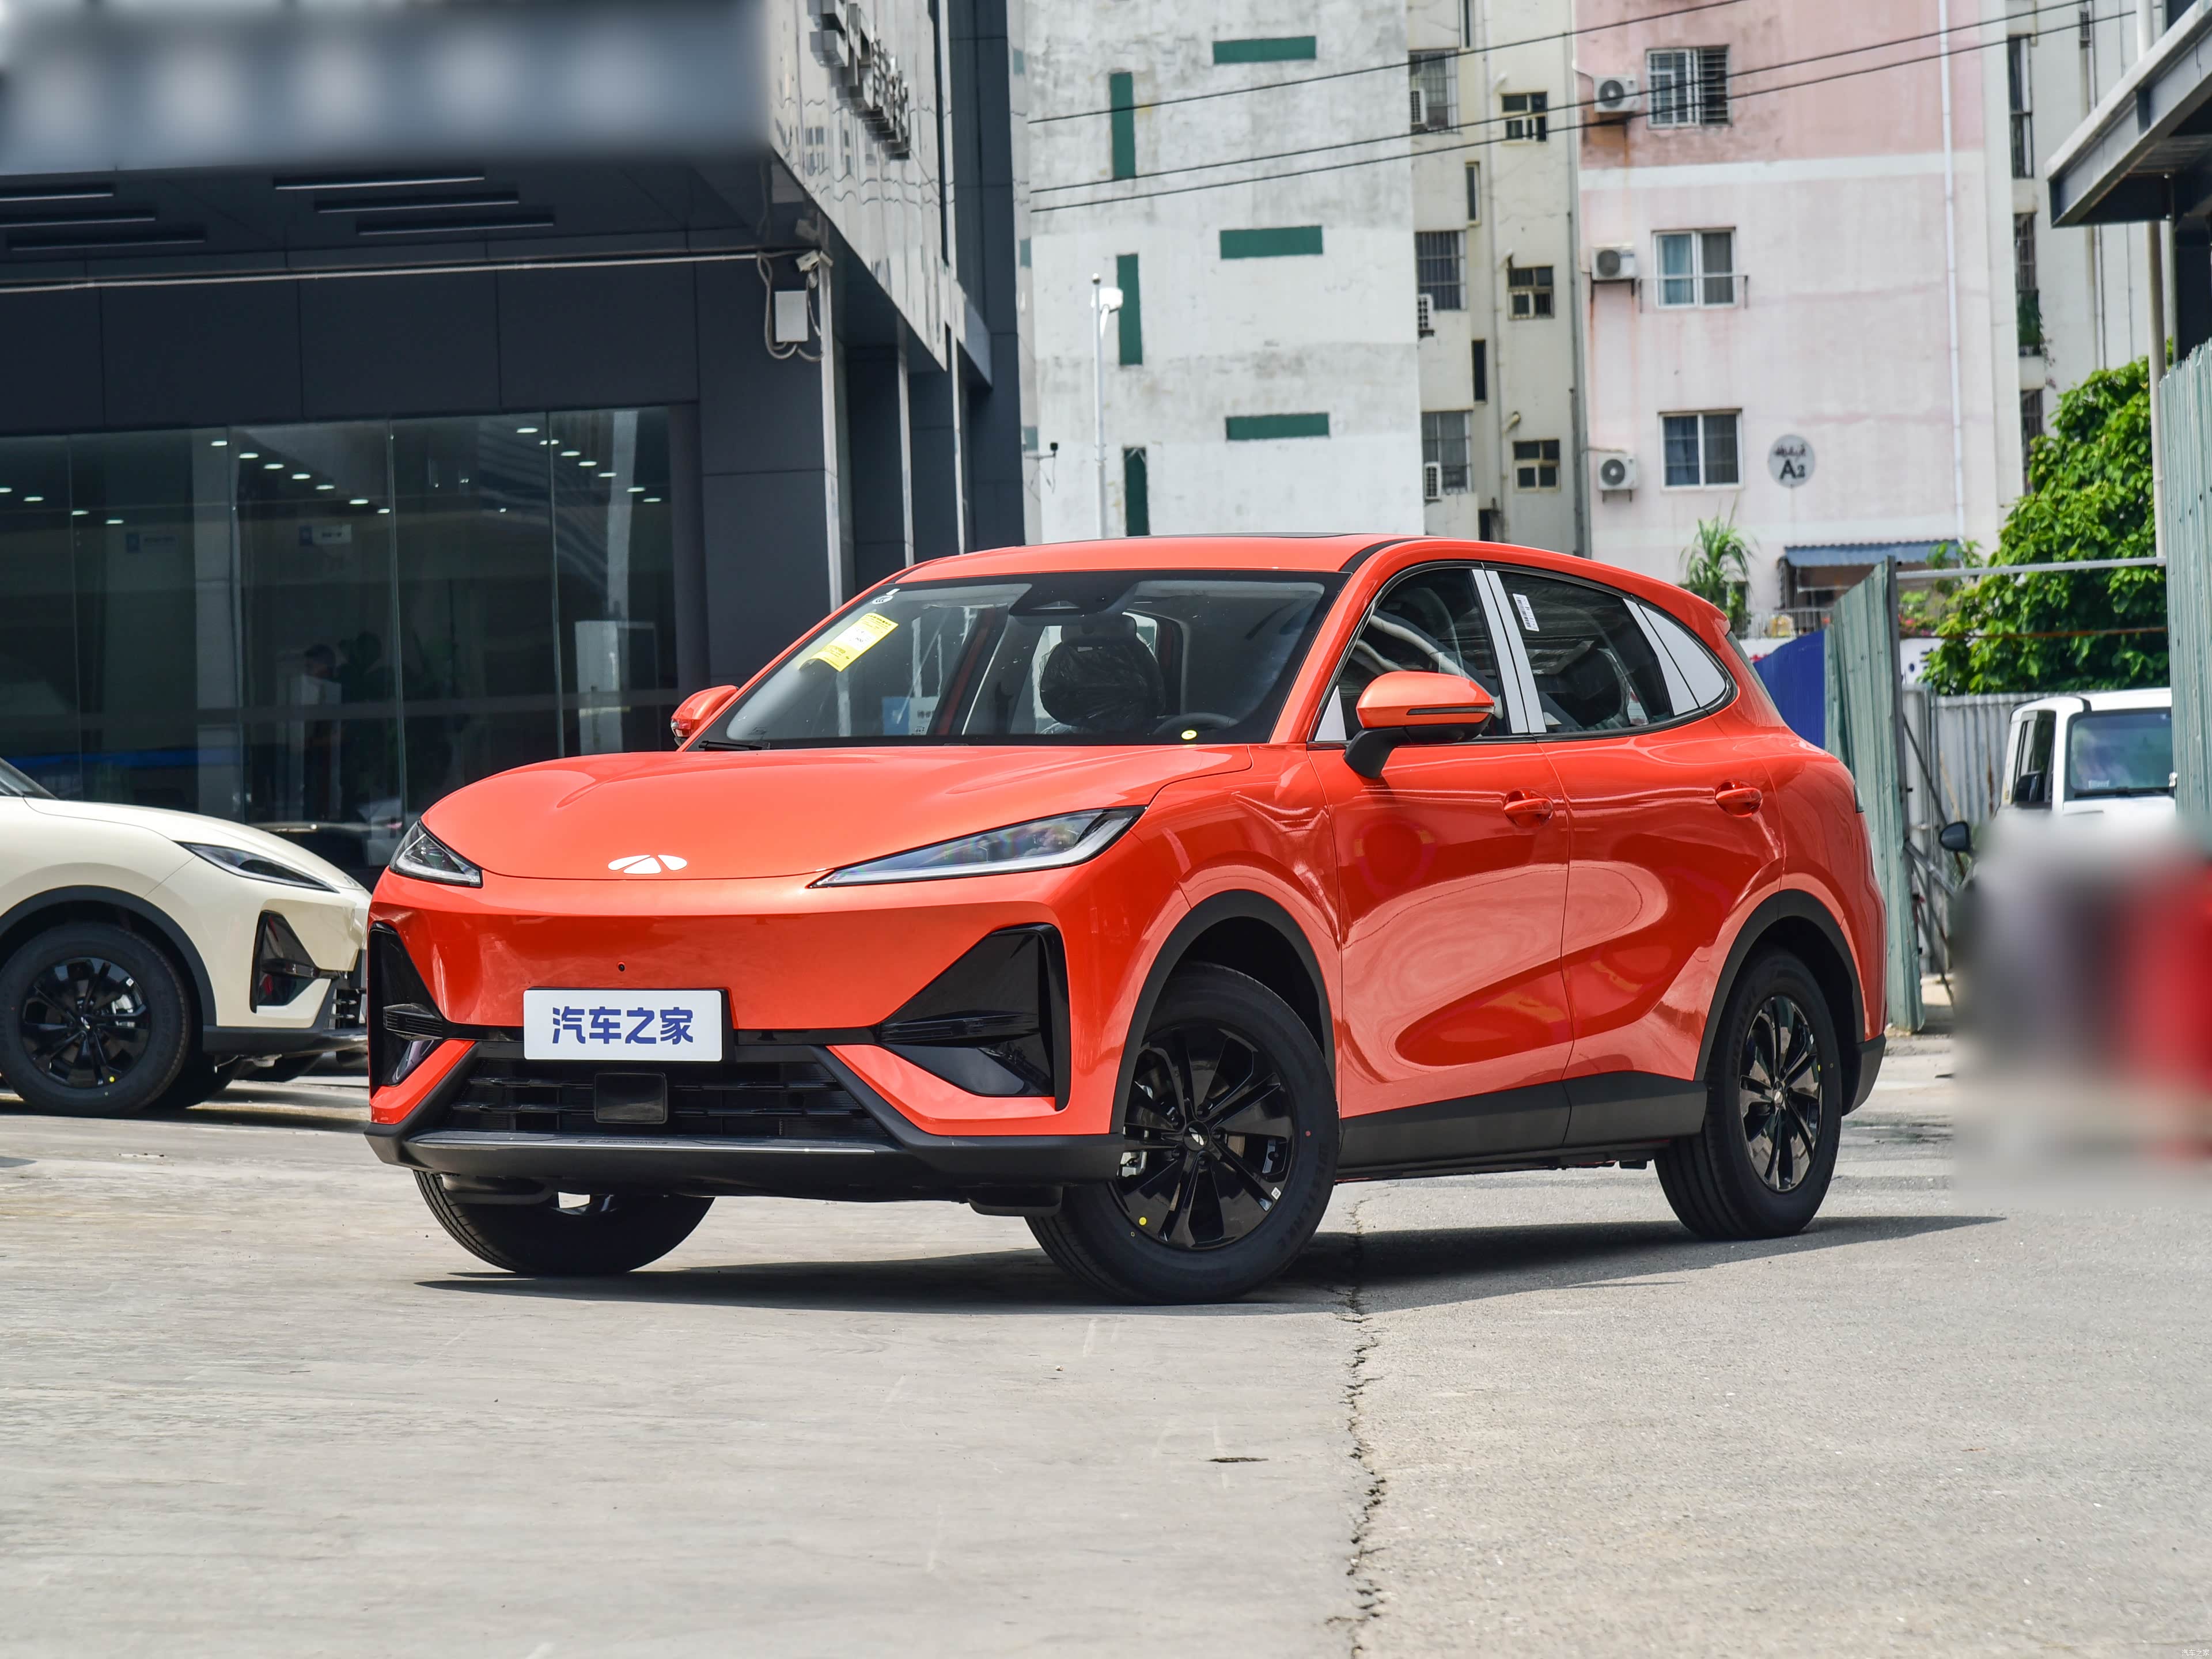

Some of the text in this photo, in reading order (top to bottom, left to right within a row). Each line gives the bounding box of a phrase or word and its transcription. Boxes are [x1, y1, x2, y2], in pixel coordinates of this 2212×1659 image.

[1779, 459, 1806, 479] A2
[552, 1006, 693, 1044] 汽车之家
